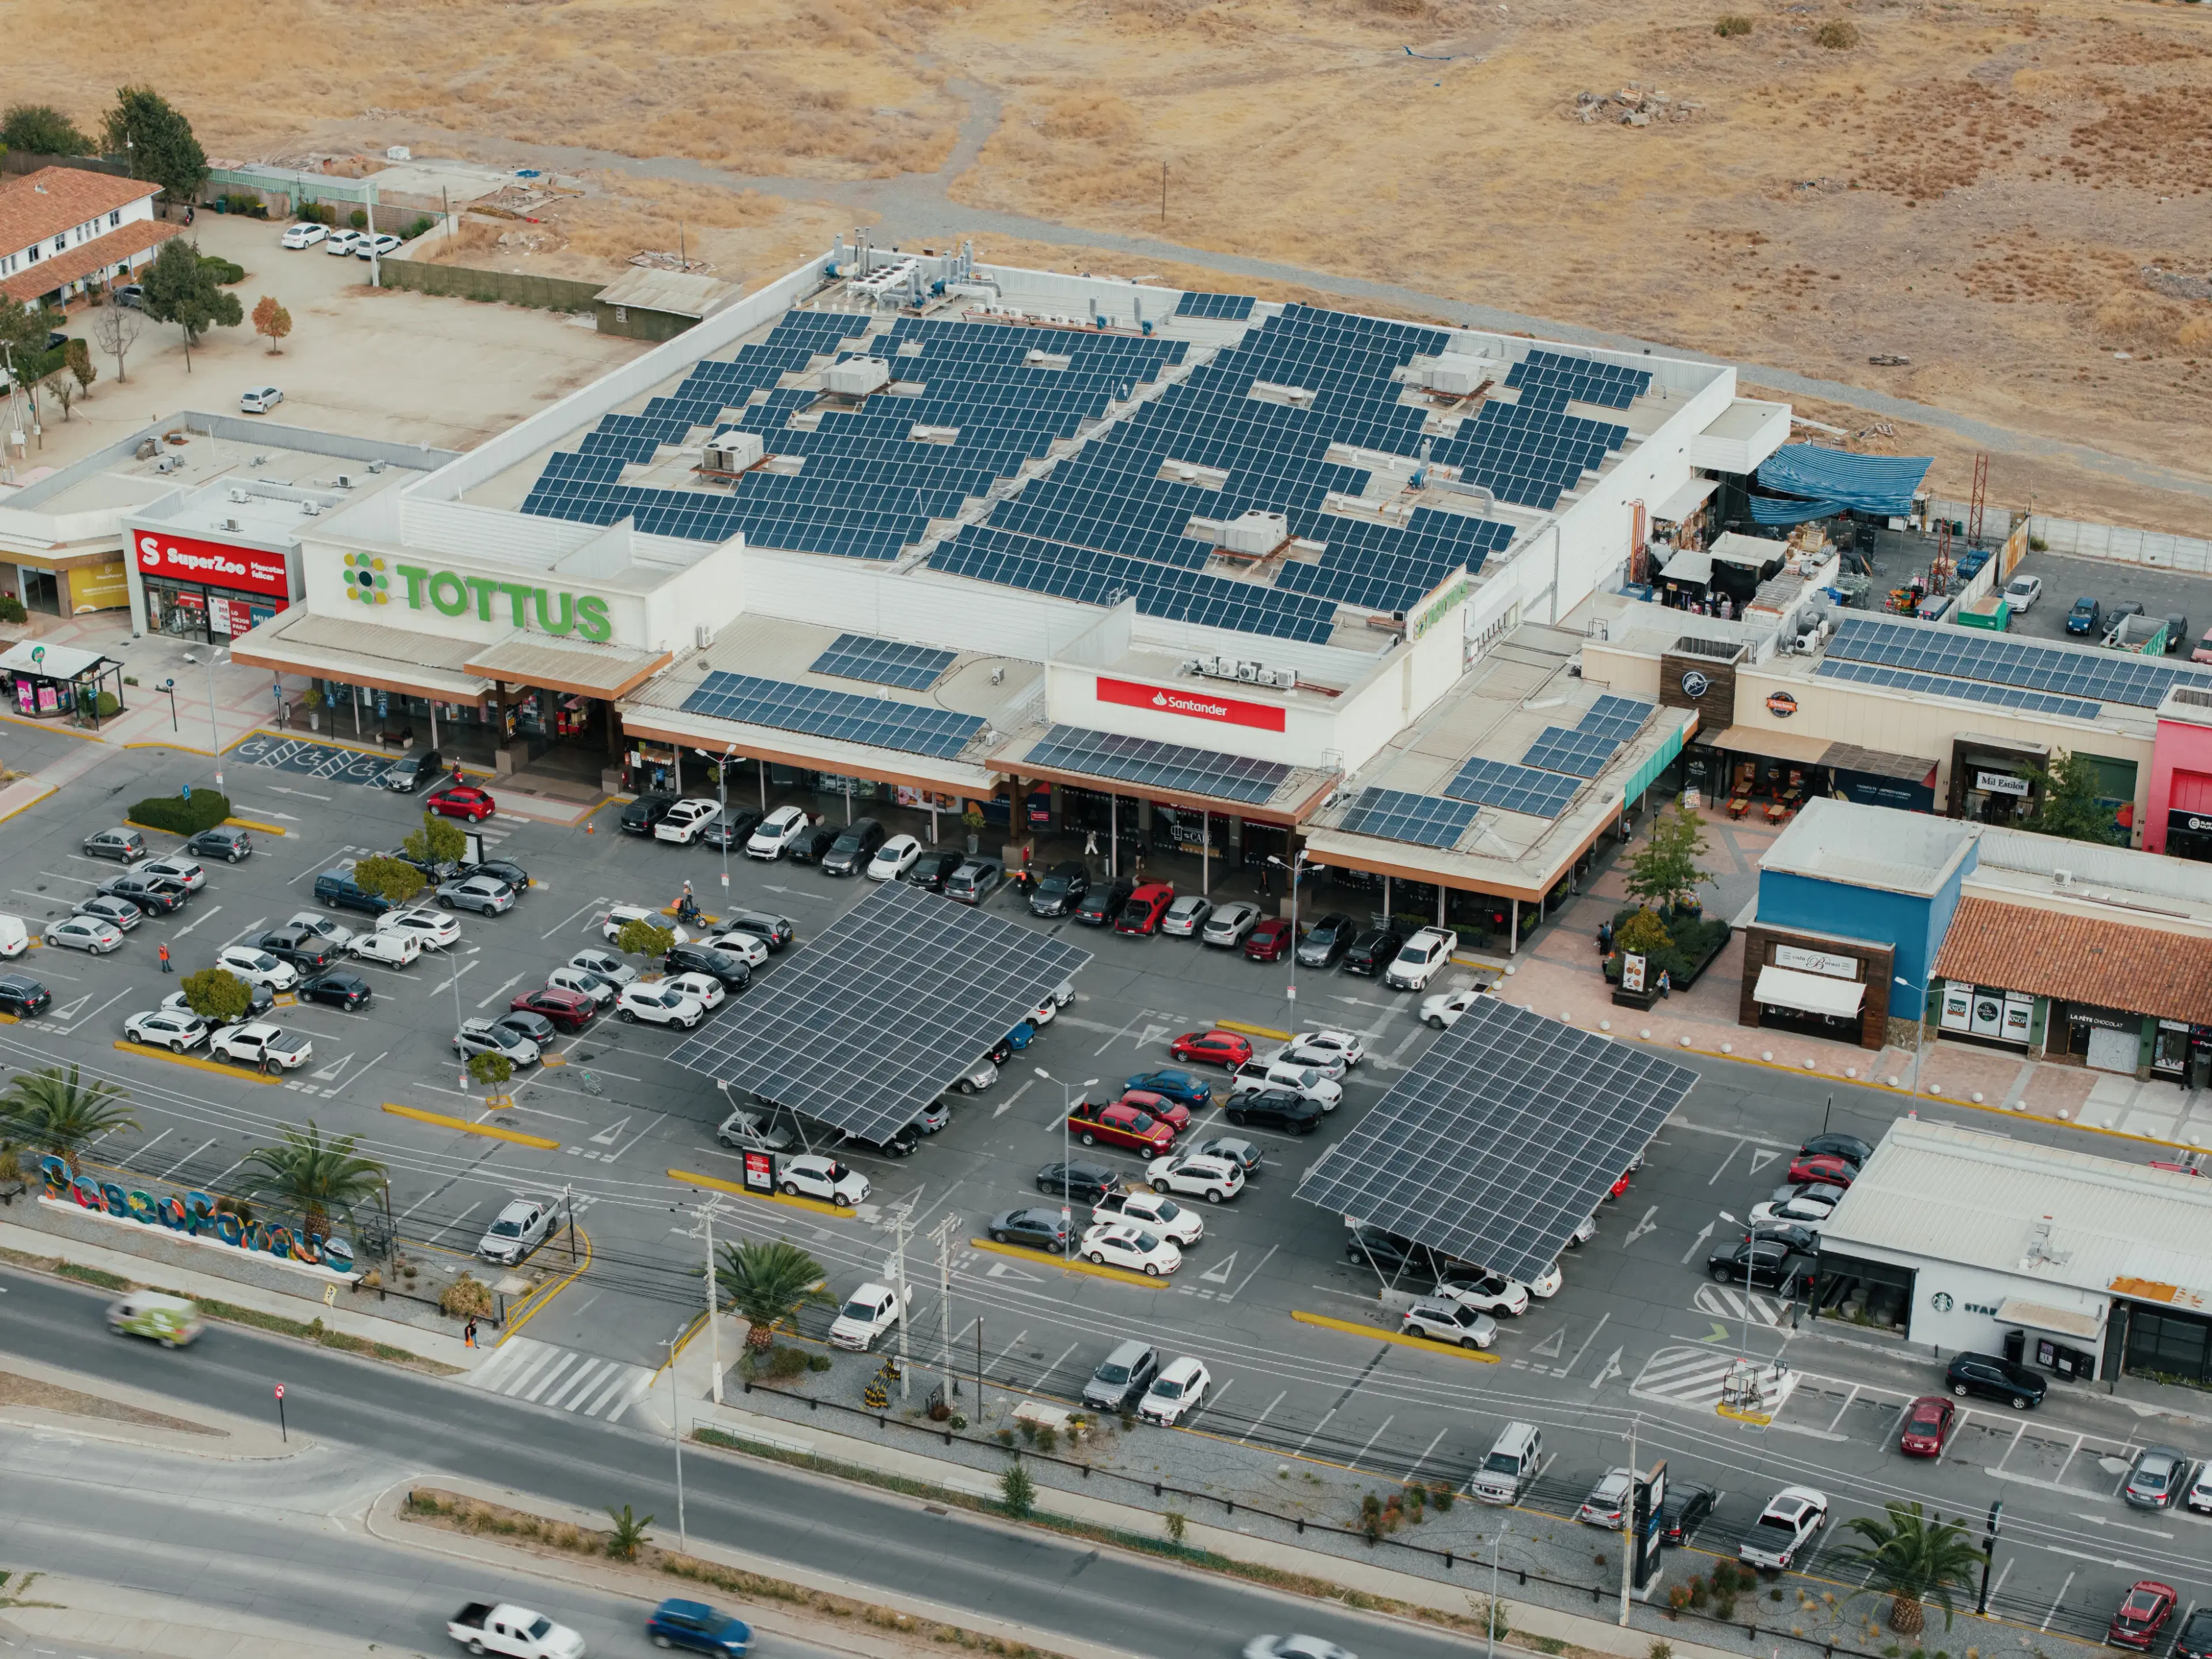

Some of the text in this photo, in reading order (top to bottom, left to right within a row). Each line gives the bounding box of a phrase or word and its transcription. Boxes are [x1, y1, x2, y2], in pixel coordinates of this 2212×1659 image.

[167, 548, 245, 575] SuperZoo
[251, 562, 285, 574] Mascotas
[396, 564, 612, 642] TOTTUS
[1168, 696, 1228, 716] Santander
[1982, 777, 2024, 790] Mil Estilos
[1878, 789, 1911, 797] ORPRENDEREMOS
[2094, 1018, 2123, 1028] CHOCOLAT
